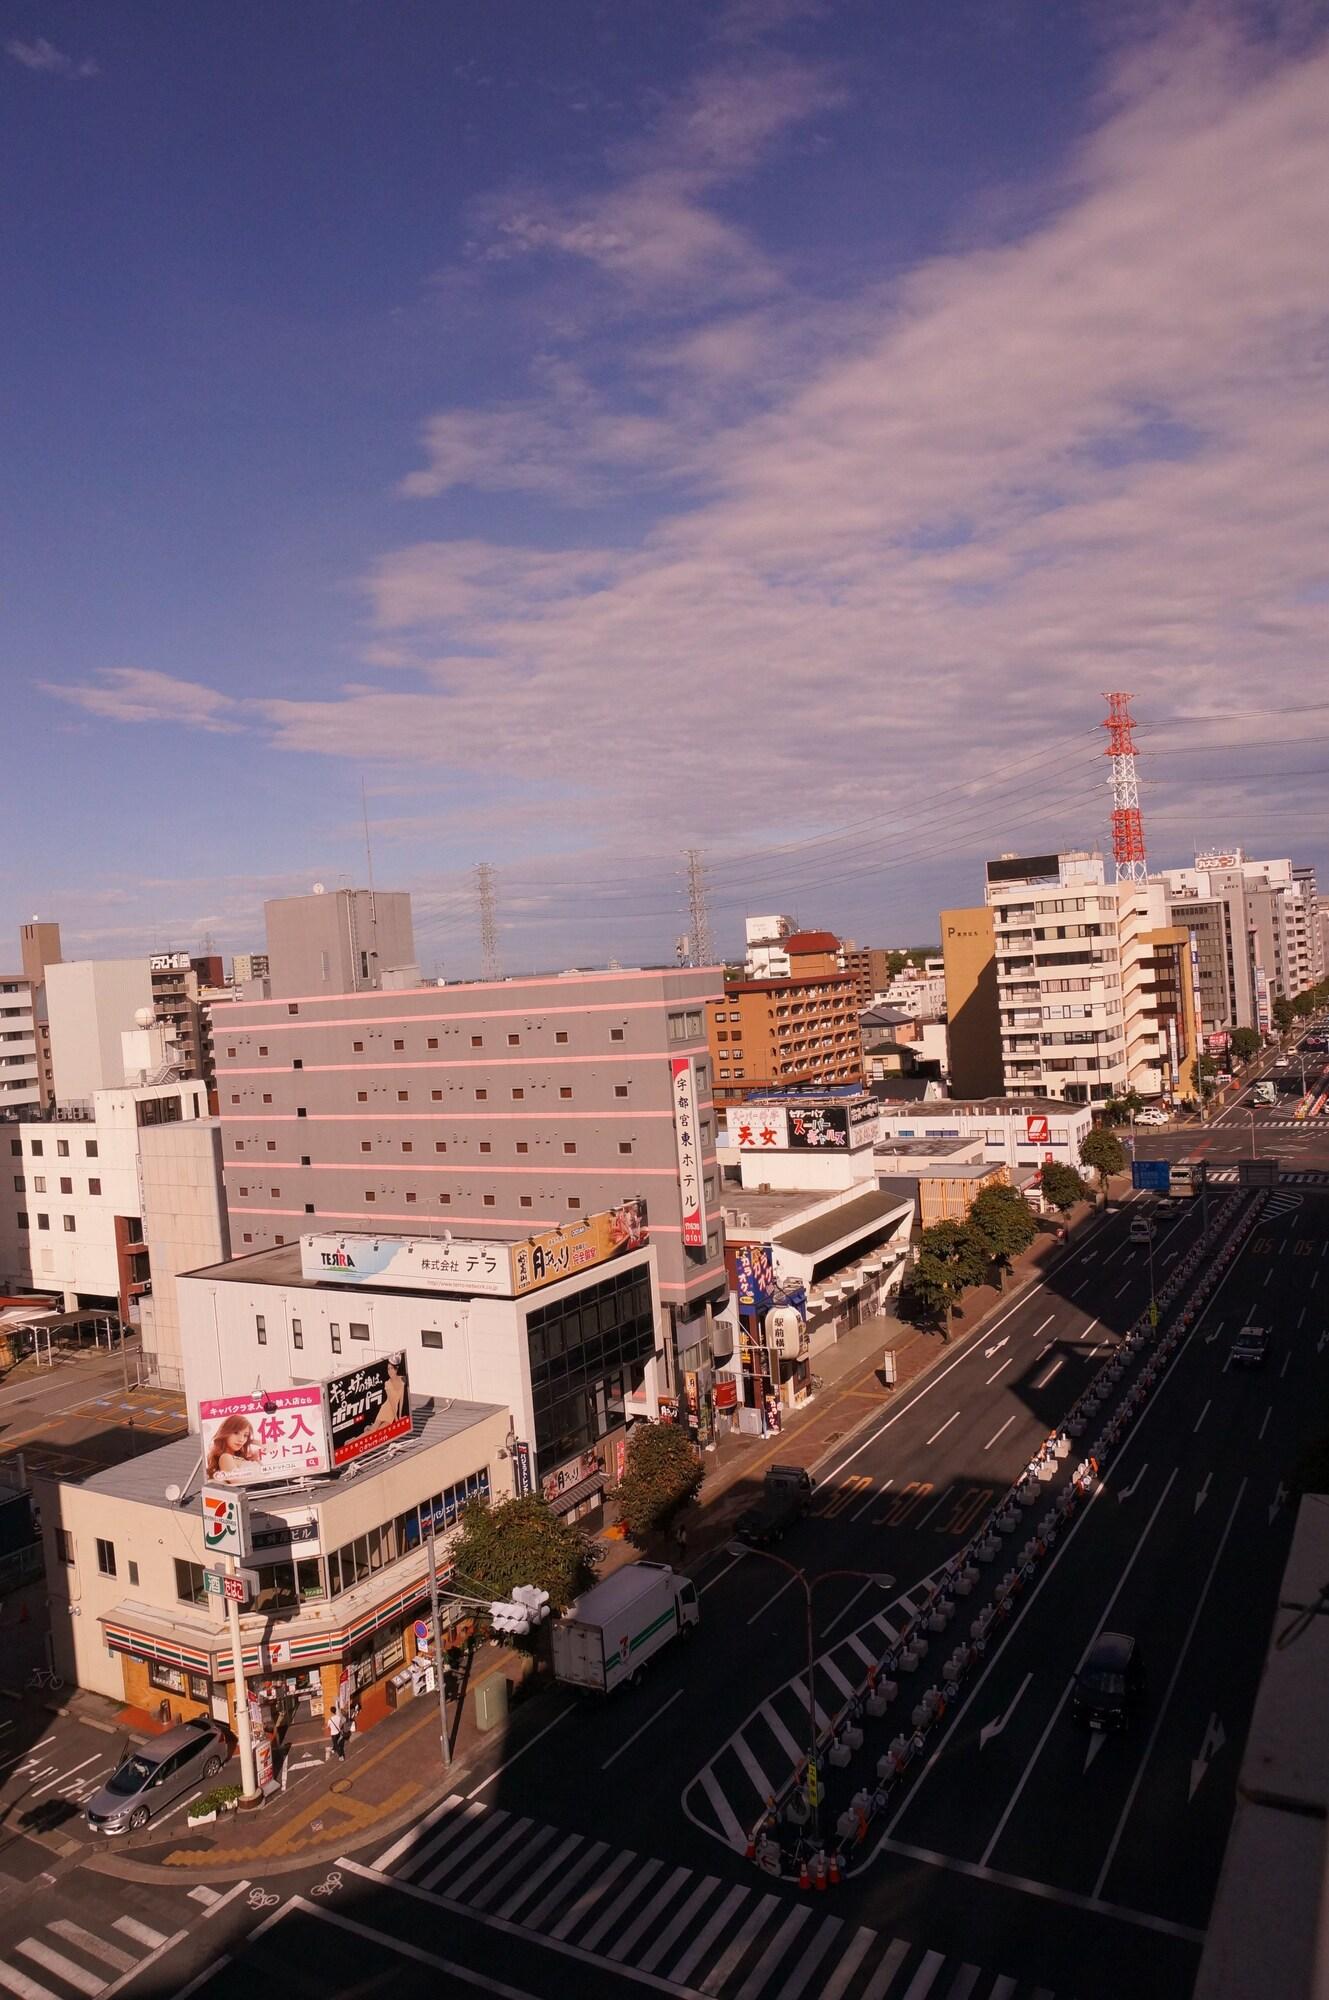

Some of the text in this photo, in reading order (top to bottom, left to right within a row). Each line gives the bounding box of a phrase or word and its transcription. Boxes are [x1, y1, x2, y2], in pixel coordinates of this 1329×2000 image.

[737, 1126, 778, 1146] 天女
[793, 1118, 831, 1135] スーパー
[676, 1077, 698, 1209] 宇都宮東ホテル
[807, 1129, 846, 1146] ギャルズ
[685, 1234, 701, 1242] 0101
[321, 1252, 355, 1267] TERRA
[421, 1256, 497, 1273] 株式会社 テラ
[532, 1245, 569, 1280] 月あかり
[332, 1390, 383, 1426] ポケパラ
[257, 1414, 315, 1445] 体入
[258, 1442, 317, 1461] ドットコム
[207, 1575, 221, 1593] 酒
[224, 1580, 243, 1599] たばこ
